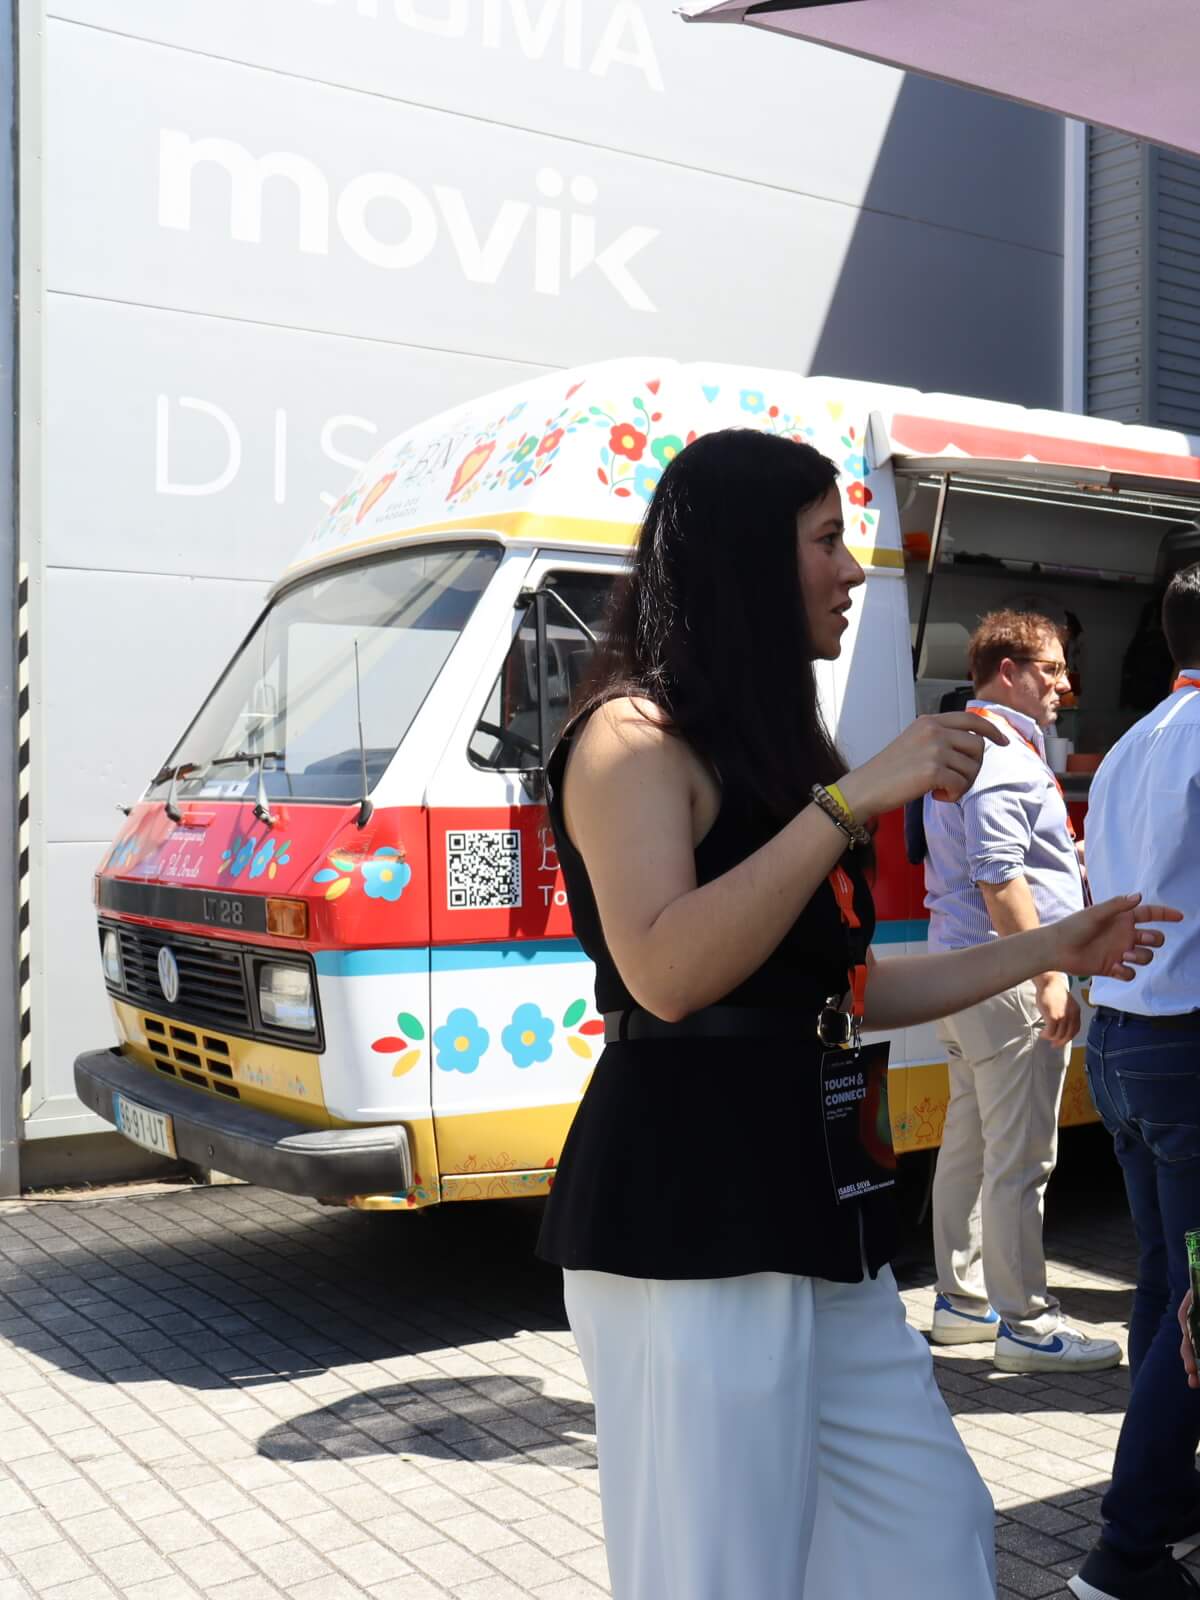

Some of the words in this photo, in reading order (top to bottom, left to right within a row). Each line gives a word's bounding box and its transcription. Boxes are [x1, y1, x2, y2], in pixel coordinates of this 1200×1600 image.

[538, 886, 568, 906] To
[220, 899, 243, 925] 28
[824, 1075, 856, 1091] TOUCH
[856, 1072, 864, 1085] &
[825, 1087, 867, 1106] CONNECT
